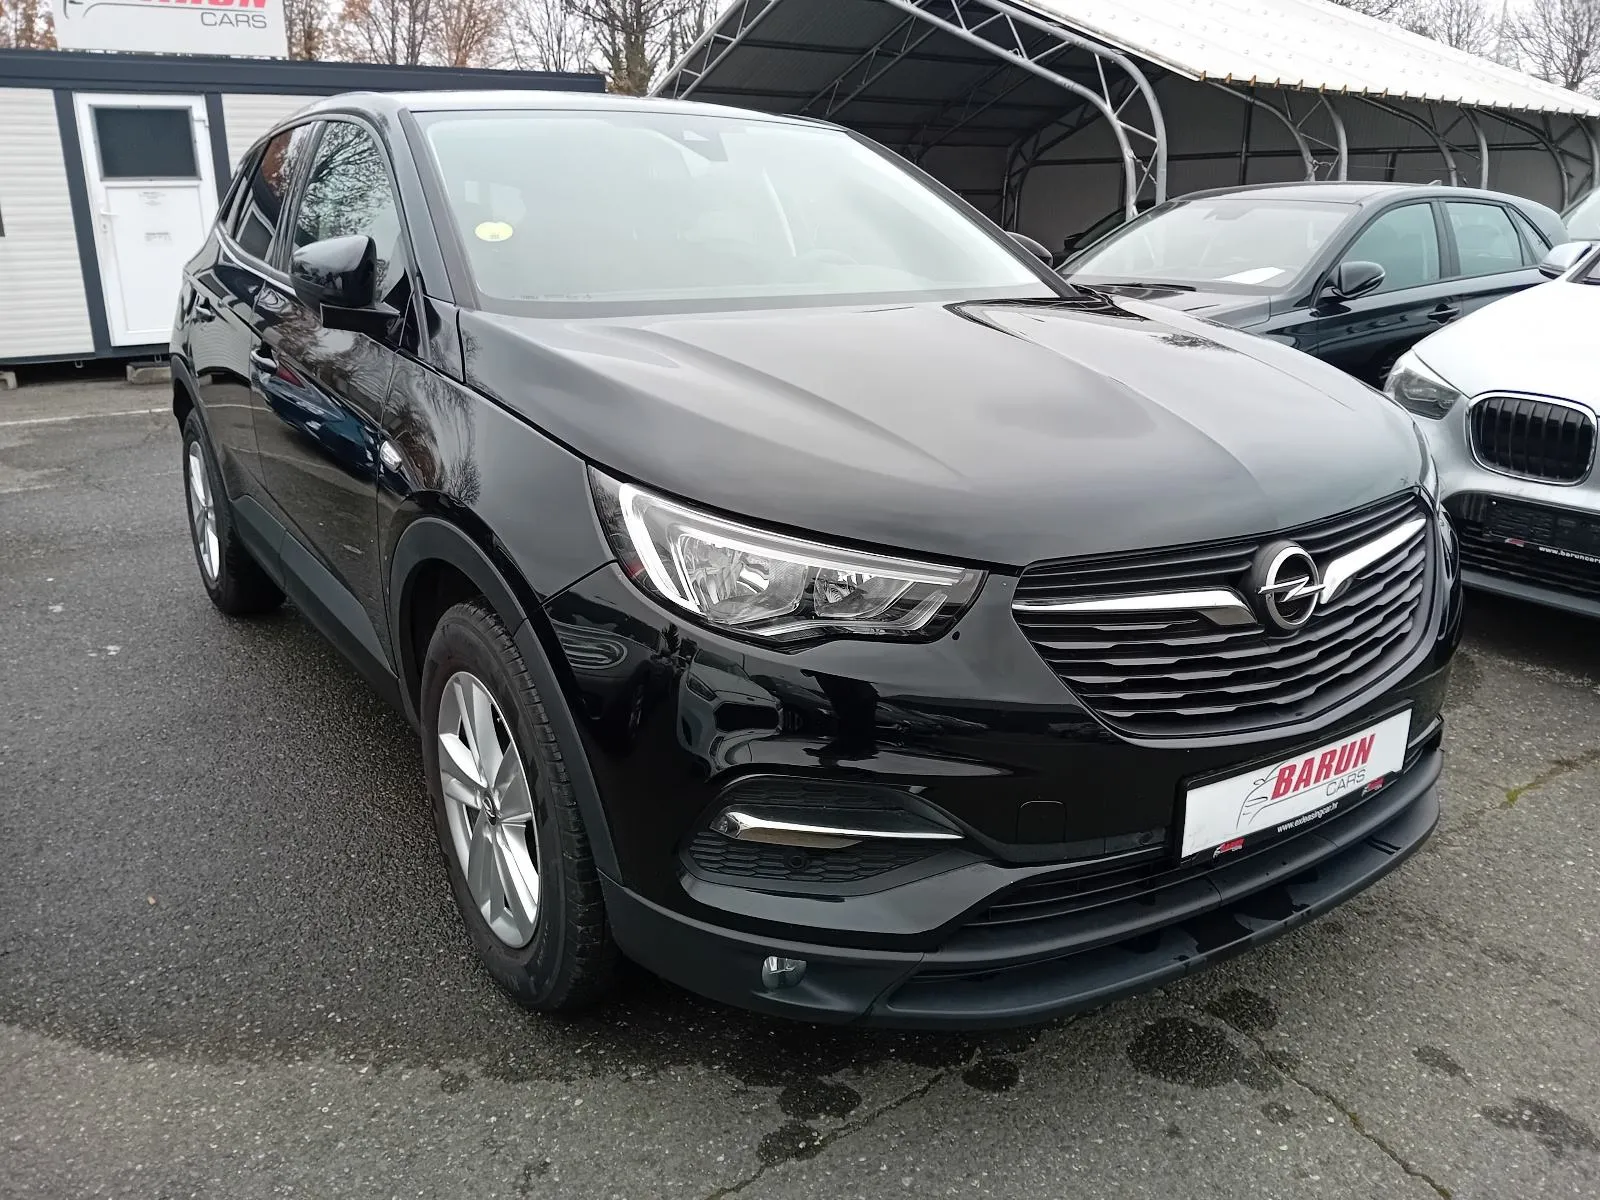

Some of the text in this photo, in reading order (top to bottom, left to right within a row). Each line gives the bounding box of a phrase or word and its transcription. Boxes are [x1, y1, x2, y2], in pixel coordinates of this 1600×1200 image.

[200, 12, 267, 29] CARS
[1271, 733, 1376, 800] BARUN
[1326, 769, 1366, 797] CARS
